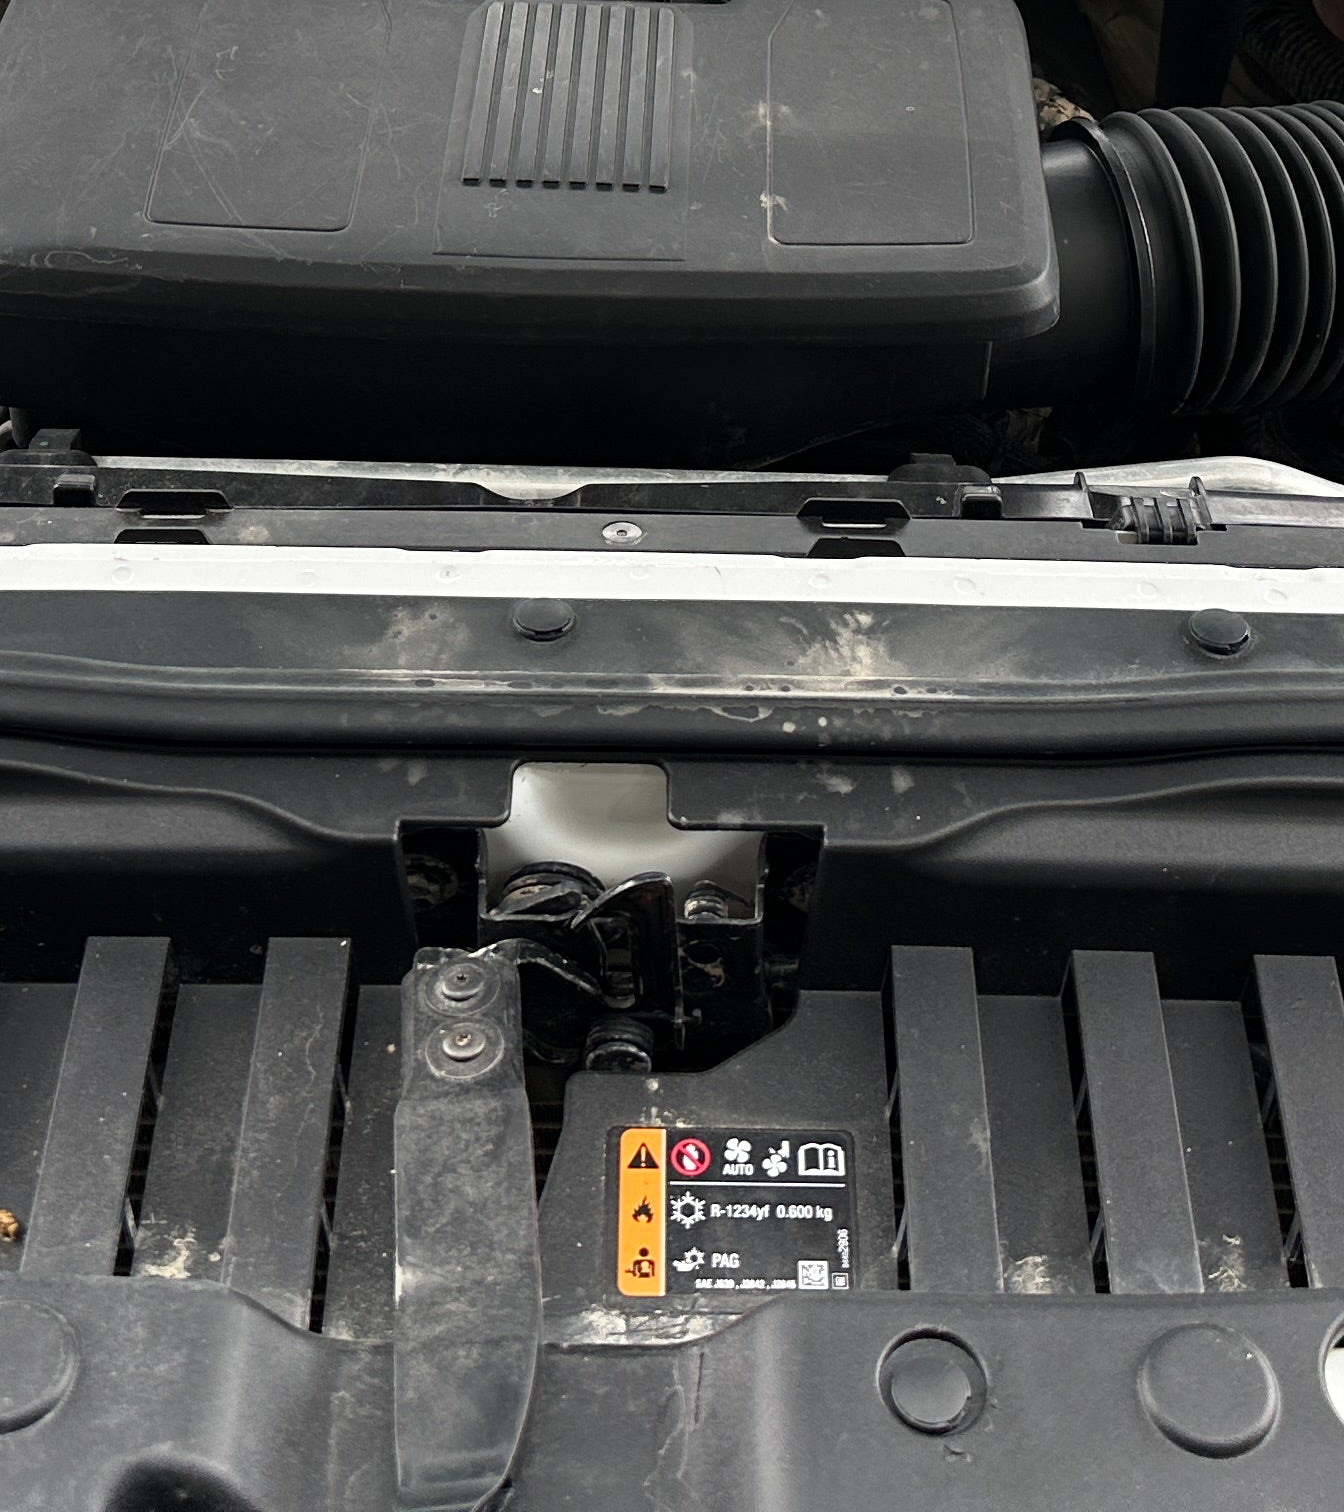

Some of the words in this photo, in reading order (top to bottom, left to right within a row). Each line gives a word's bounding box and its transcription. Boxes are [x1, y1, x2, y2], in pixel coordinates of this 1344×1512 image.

[722, 1163, 754, 1176] AUTO
[710, 1203, 770, 1221] R-1234yf
[776, 1204, 813, 1219] 0.600
[816, 1204, 833, 1222] kg
[711, 1252, 741, 1269] PAG
